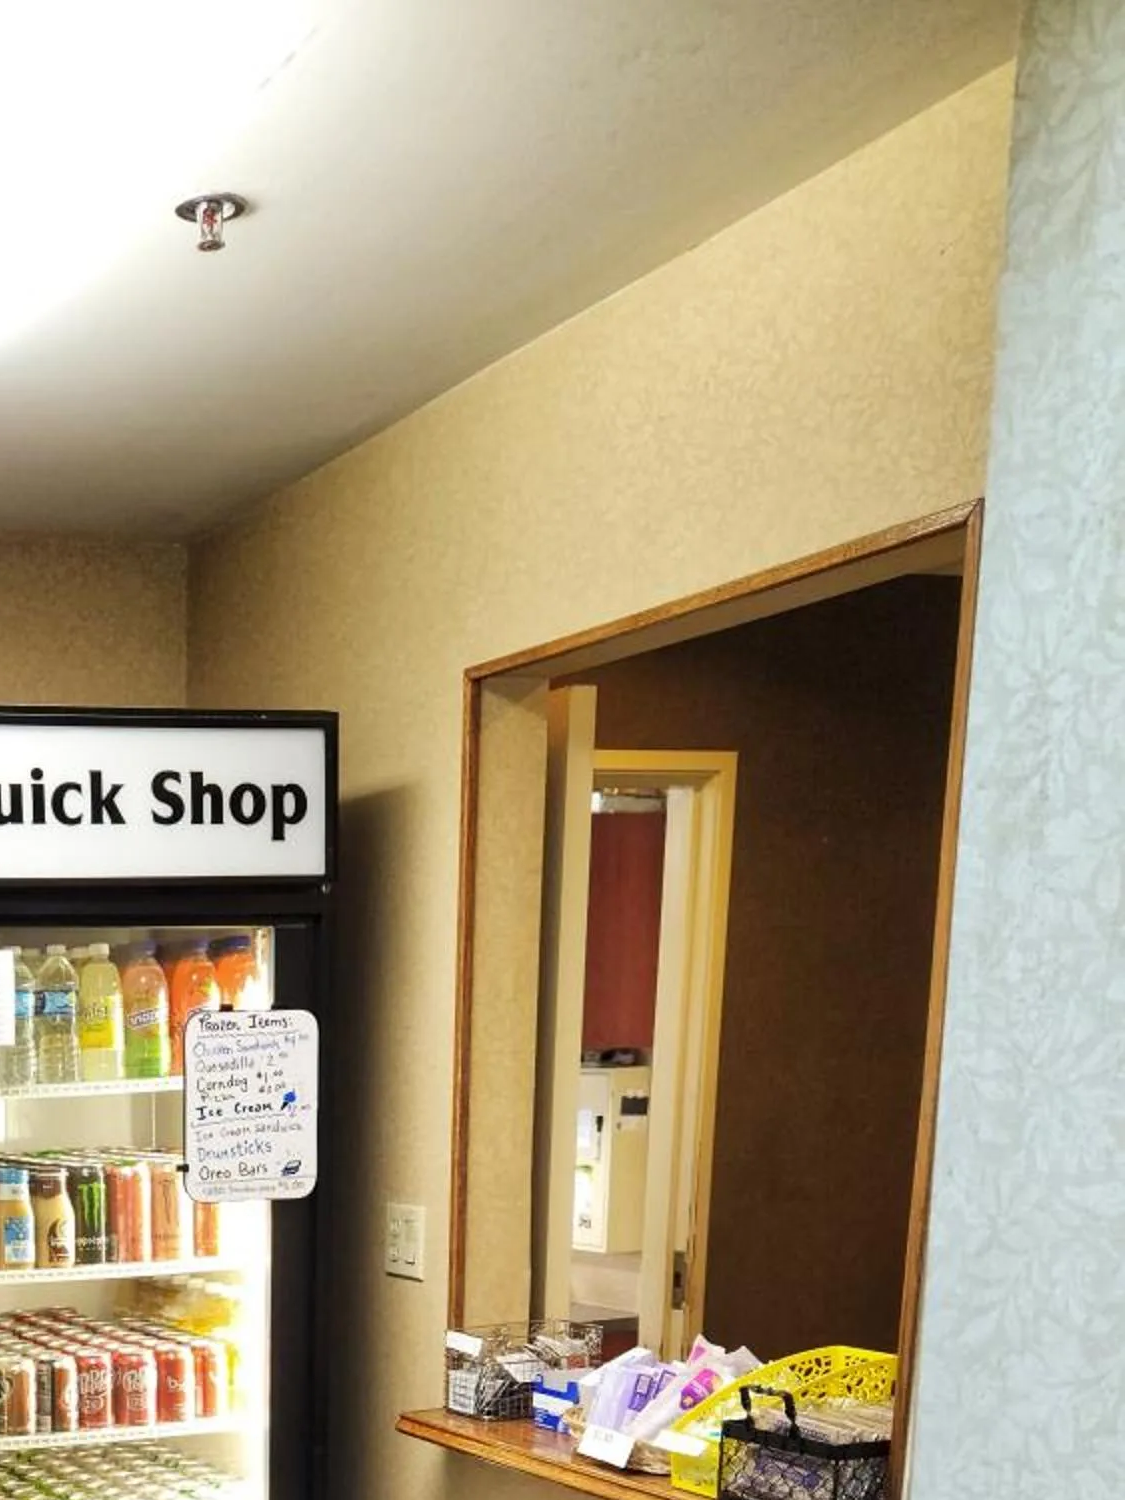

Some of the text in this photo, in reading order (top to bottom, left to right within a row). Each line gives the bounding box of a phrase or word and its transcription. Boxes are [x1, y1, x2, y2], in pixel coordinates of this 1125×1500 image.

[151, 770, 308, 842] Shop
[195, 1106, 224, 1121] Ice
[234, 1102, 274, 1115] Cream
[197, 1138, 272, 1163] Drumsticks
[198, 1161, 268, 1181] Oreo Bars
